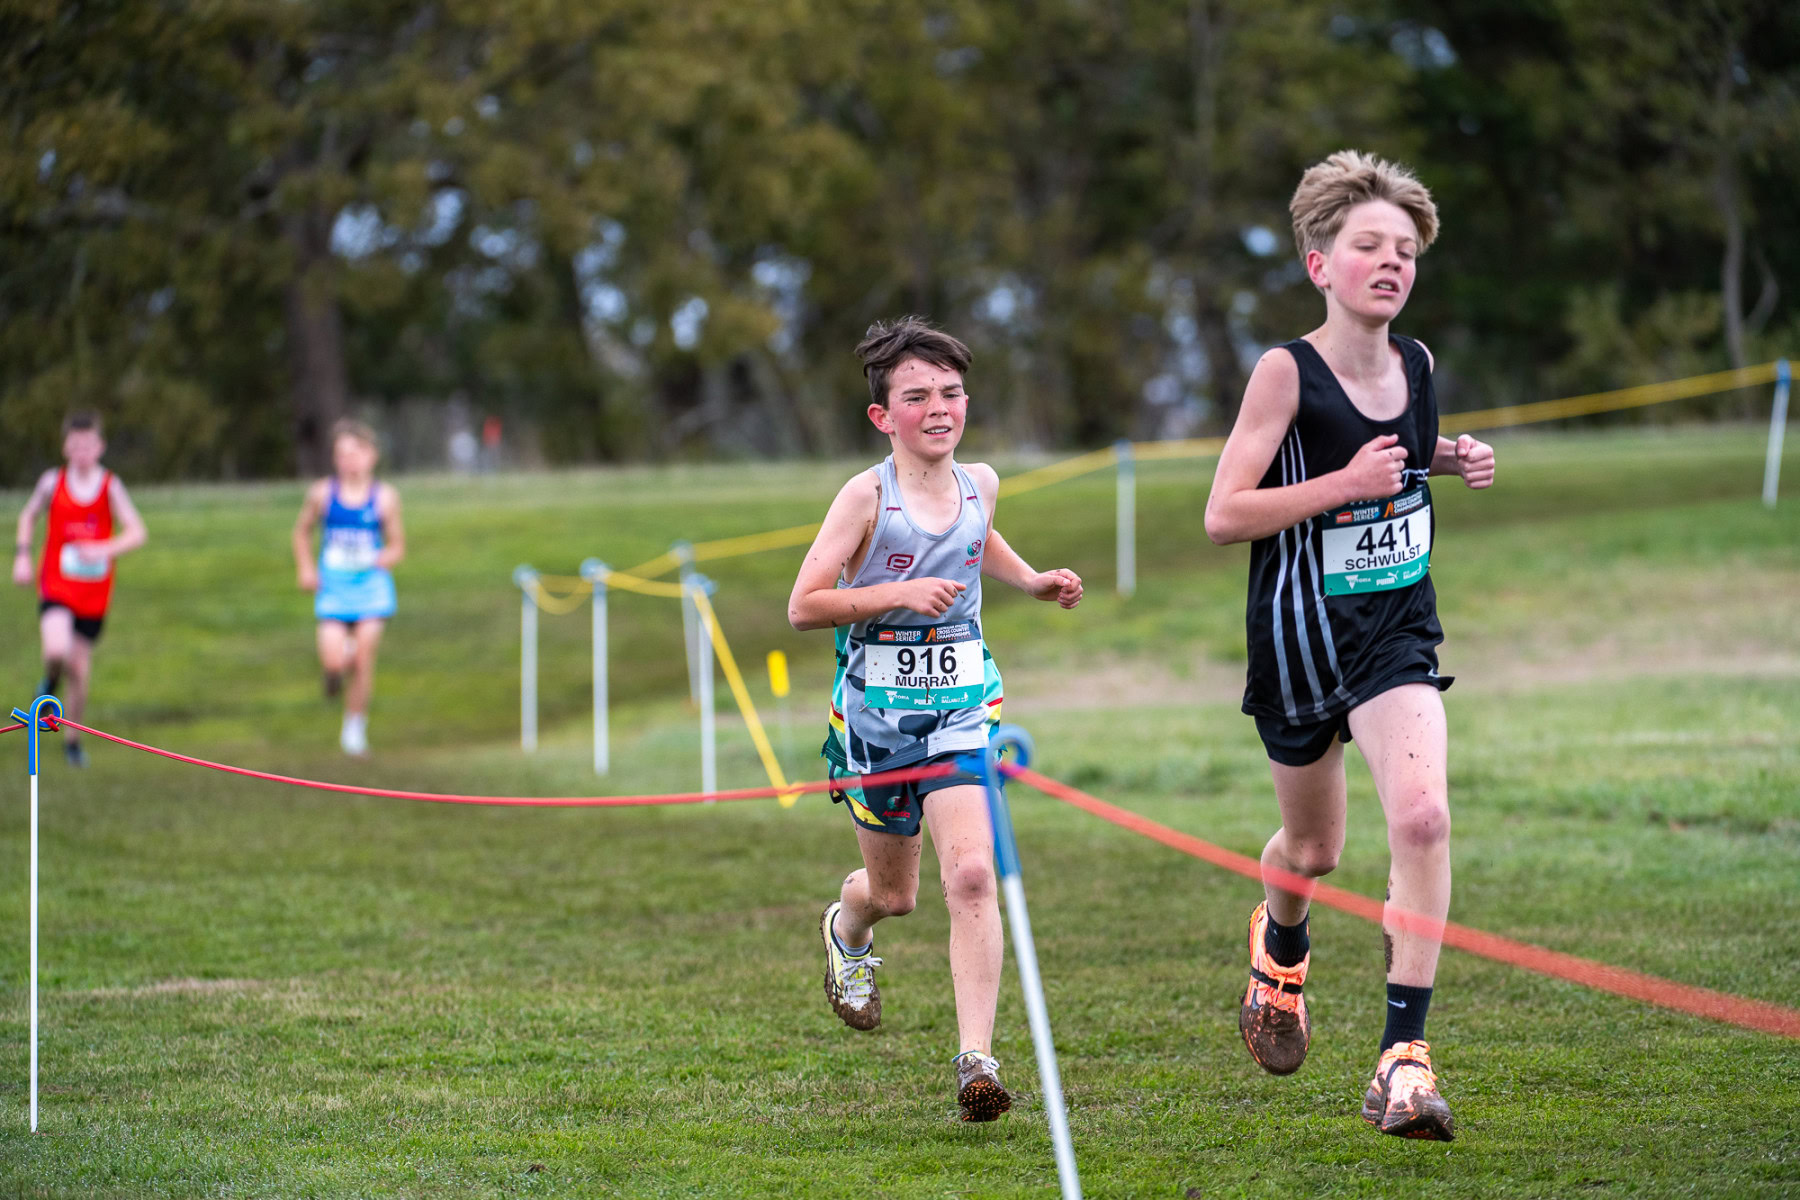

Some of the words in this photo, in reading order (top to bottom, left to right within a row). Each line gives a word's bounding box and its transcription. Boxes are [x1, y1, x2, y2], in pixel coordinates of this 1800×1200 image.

[1353, 507, 1379, 516] WINTER
[1353, 513, 1375, 522] SERIES
[1356, 518, 1411, 555] 441
[1345, 544, 1421, 570] SCHWULST
[1376, 577, 1395, 586] PUMA
[897, 645, 957, 675] 916
[895, 674, 959, 687] MURRAY
